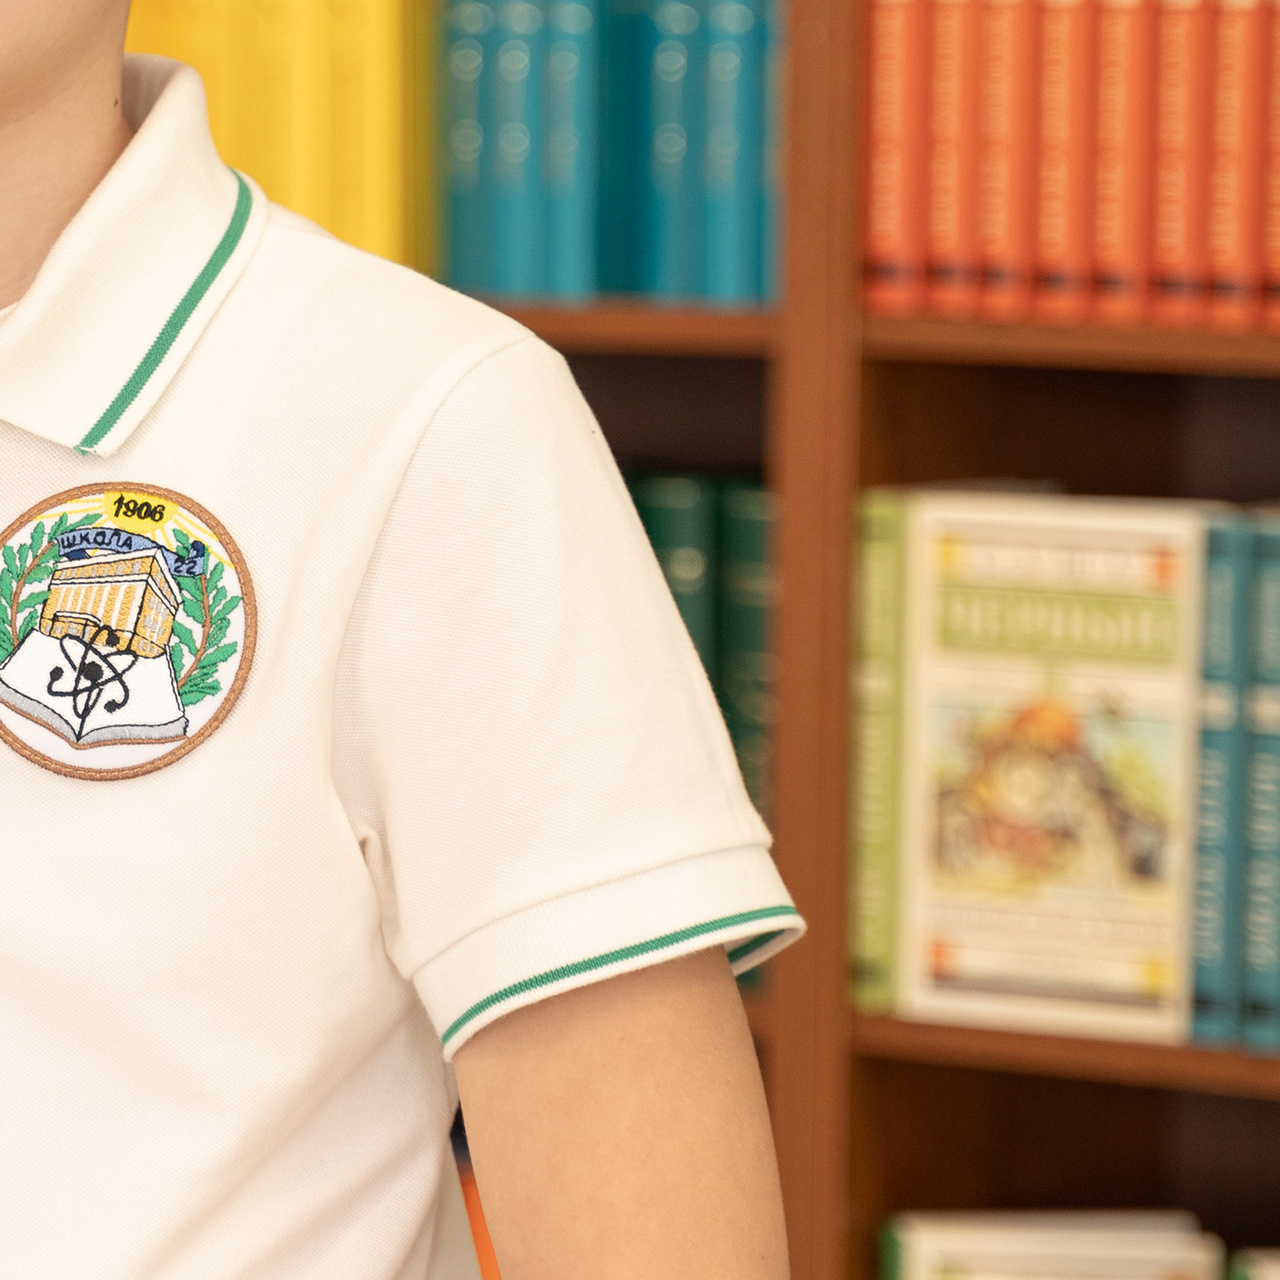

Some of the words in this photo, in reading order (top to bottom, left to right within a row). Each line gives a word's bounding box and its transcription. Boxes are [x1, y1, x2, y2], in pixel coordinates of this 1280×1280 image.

[113, 493, 166, 523] 1906
[60, 531, 133, 550] ШКОЛА
[173, 557, 198, 574] 22
